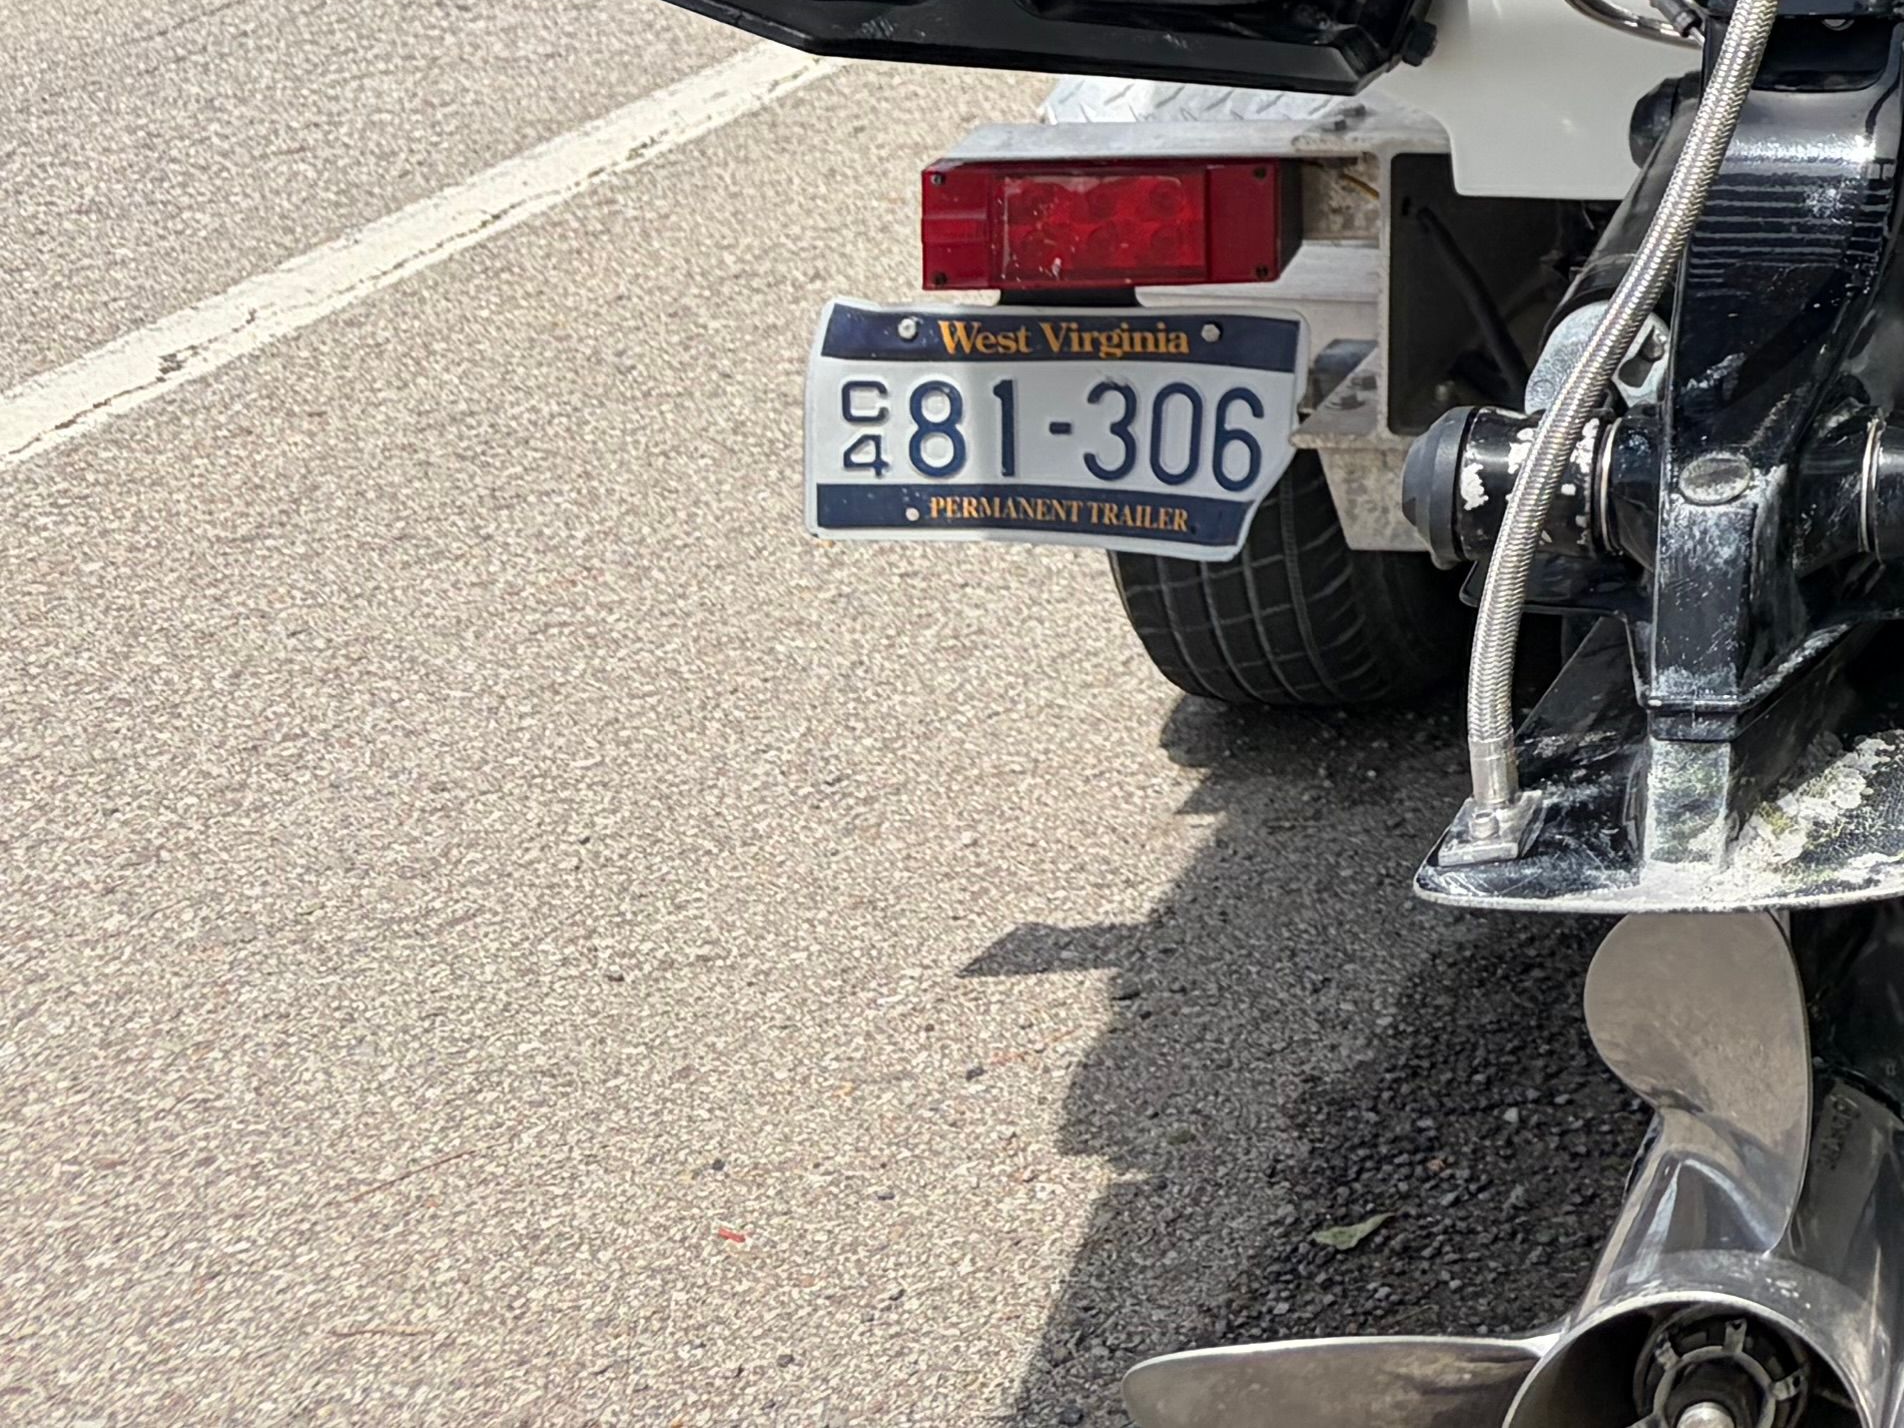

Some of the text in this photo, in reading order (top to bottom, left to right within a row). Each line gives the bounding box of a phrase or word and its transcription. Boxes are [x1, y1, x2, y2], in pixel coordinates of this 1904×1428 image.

[937, 319, 1190, 358] West Virginia
[908, 379, 1265, 493] 81-306
[930, 496, 1189, 533] PERMANENT TRAILER
